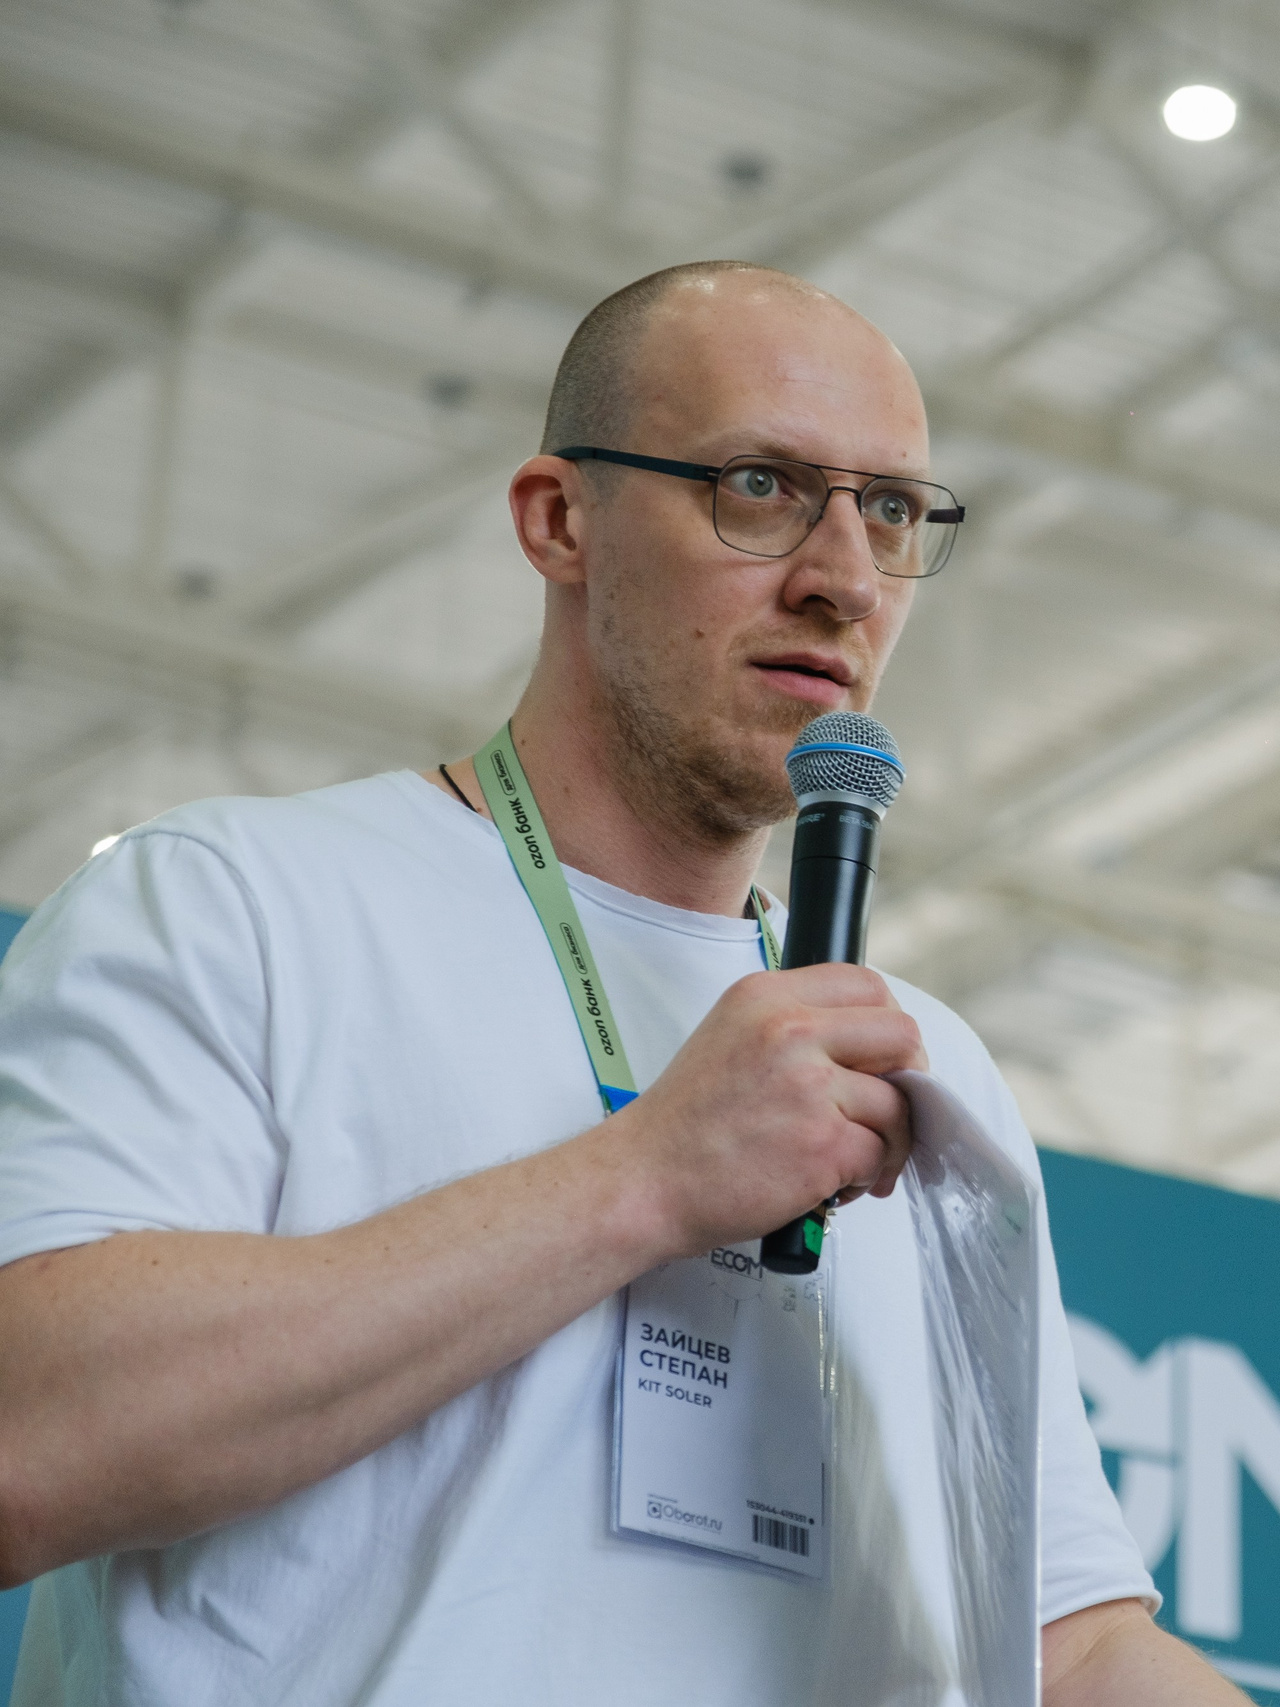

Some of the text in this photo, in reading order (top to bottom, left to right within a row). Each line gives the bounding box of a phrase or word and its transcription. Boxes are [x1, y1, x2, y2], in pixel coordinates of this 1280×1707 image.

[508, 799, 532, 836] банк
[524, 834, 546, 869] ozon
[580, 977, 602, 1018] банк
[594, 1020, 614, 1056] ozon
[711, 1247, 763, 1279] ECOM
[640, 1323, 731, 1364] ЗАЙЦЕВ
[639, 1349, 728, 1389] СТЕПАН
[638, 1377, 712, 1409] KIT SOLER
